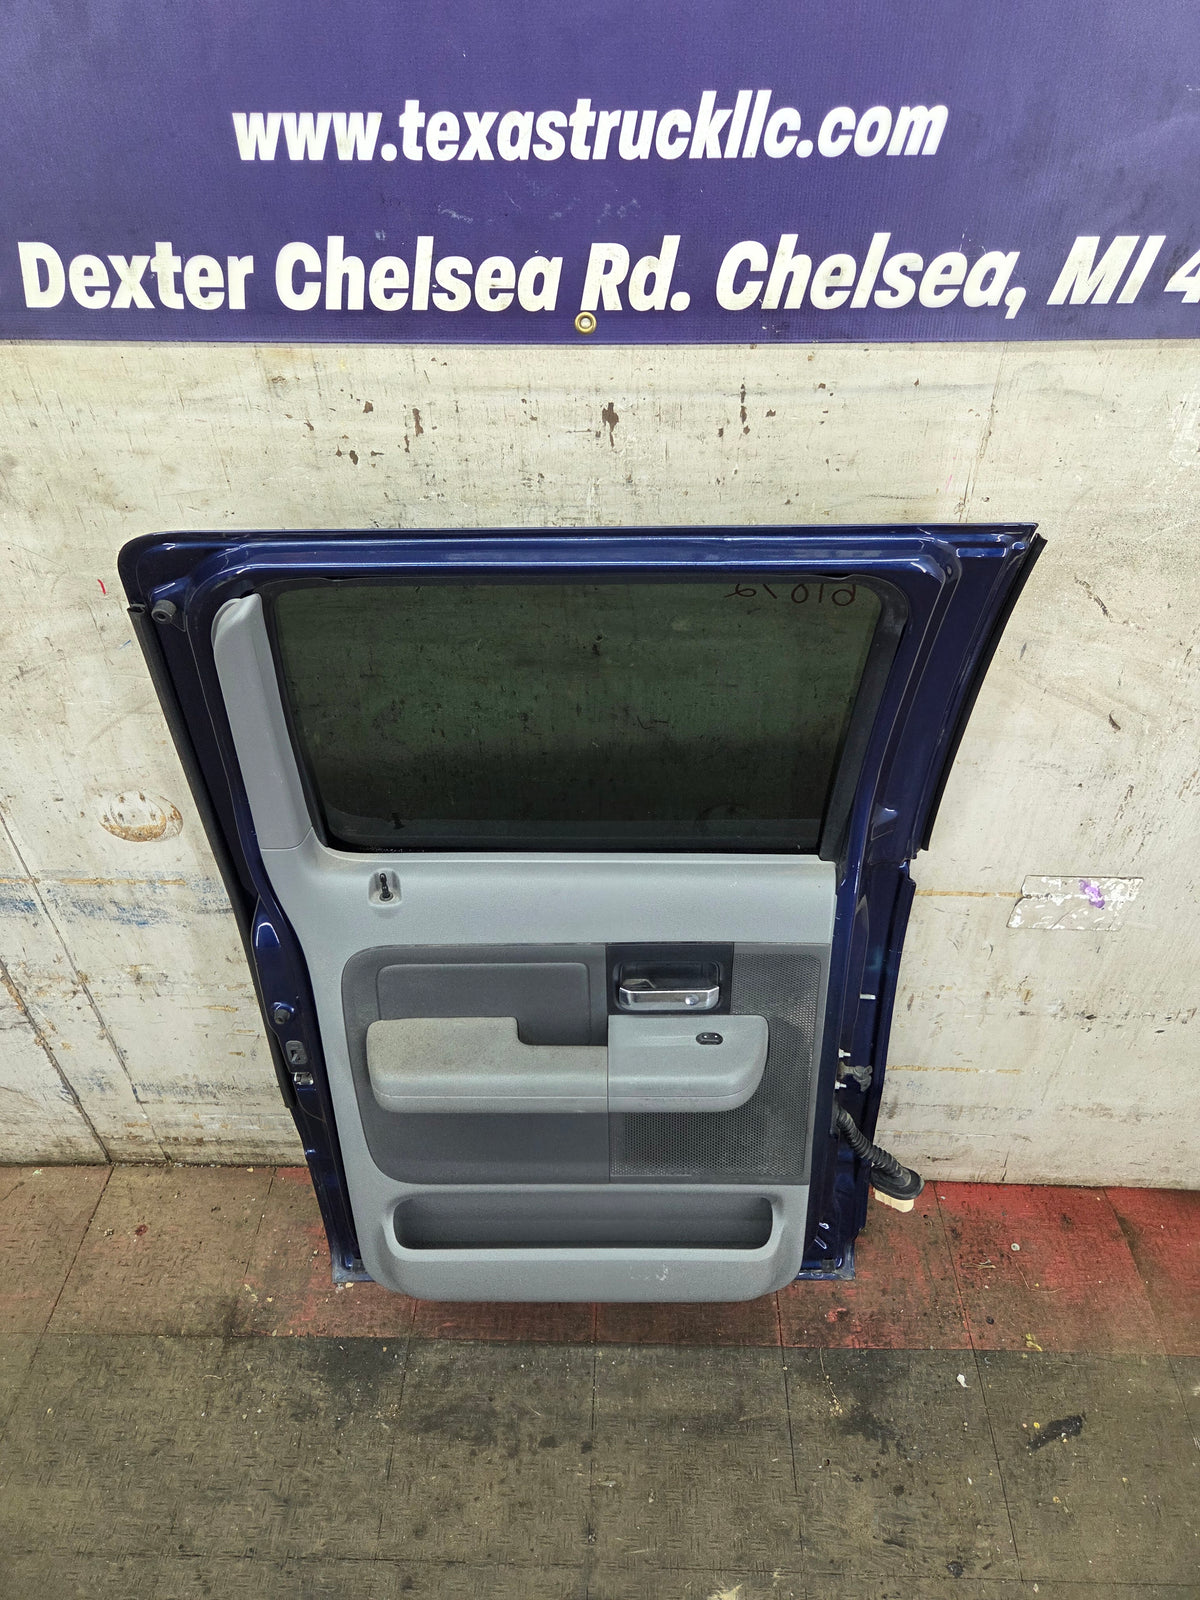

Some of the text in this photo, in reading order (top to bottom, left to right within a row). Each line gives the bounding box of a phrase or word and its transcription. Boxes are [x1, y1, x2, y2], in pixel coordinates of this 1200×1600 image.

[231, 89, 949, 162] www.texastruckllc.com
[17, 241, 254, 311] Dexter
[275, 235, 563, 312] Chelsea
[580, 234, 691, 312] Rd.
[715, 232, 1027, 319] Chelsea,
[1046, 234, 1167, 305] MI
